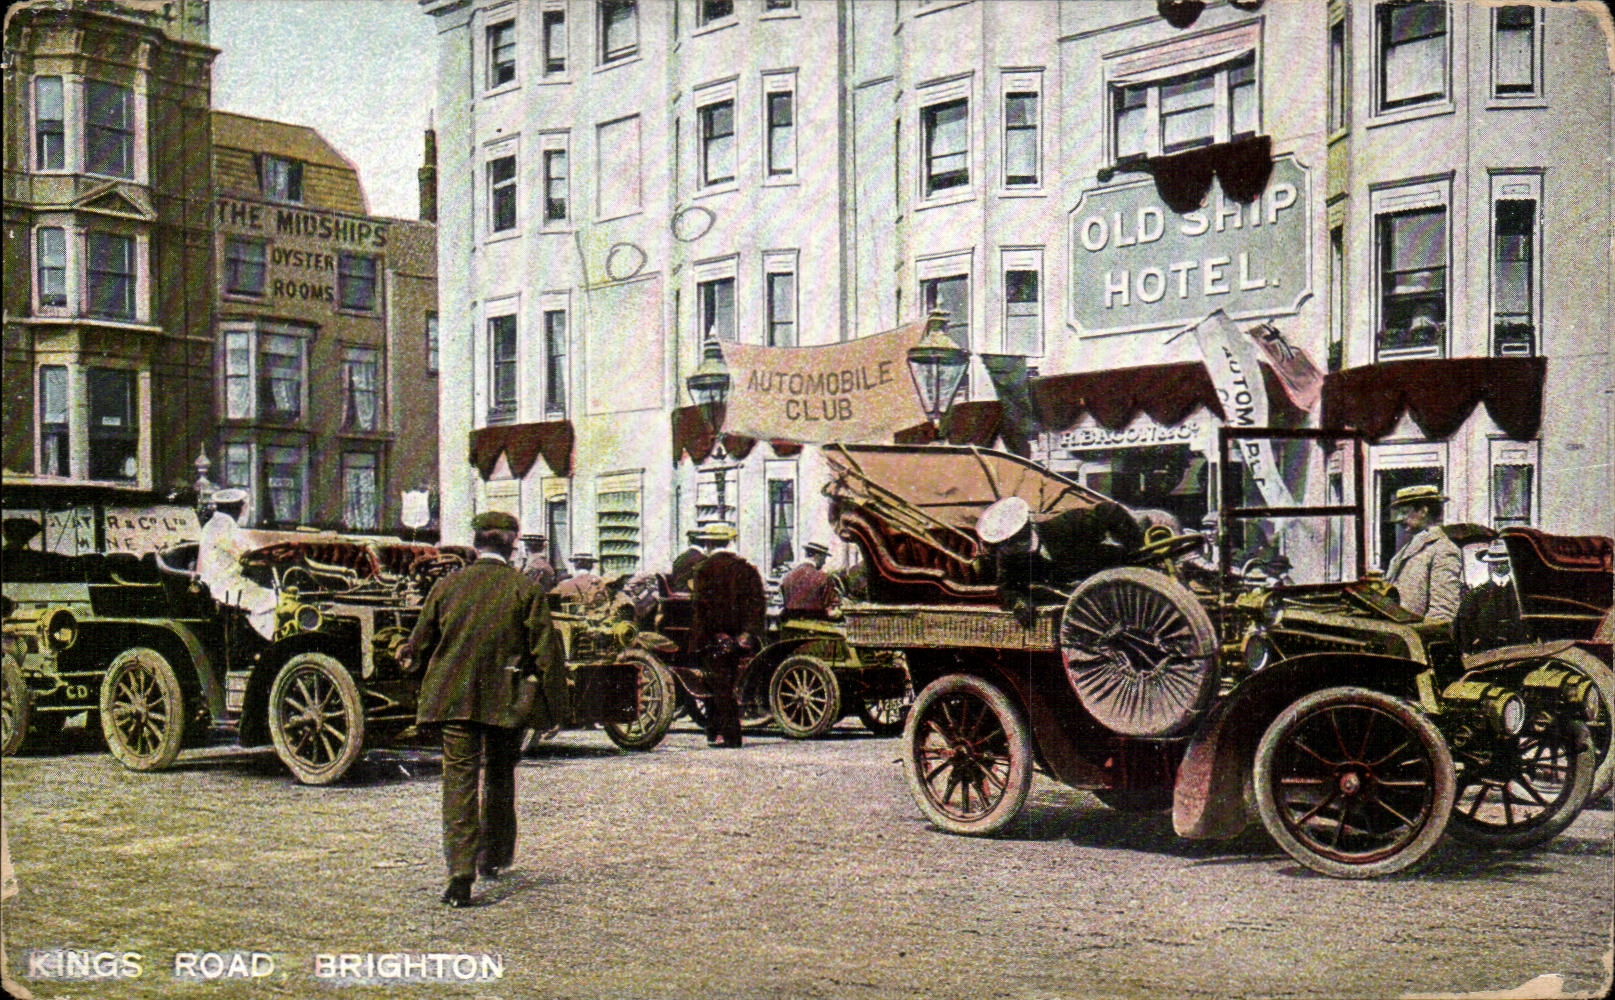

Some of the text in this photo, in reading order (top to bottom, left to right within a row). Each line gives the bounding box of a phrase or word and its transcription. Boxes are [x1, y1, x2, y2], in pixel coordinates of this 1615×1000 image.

[217, 200, 388, 248] THE MIDSHIPS
[1080, 182, 1298, 253] OLD SHIP
[271, 248, 335, 272] OYSTER
[273, 279, 335, 302] ROOMS
[748, 360, 894, 396] AUTOMOBILE
[786, 398, 853, 422] CLUB
